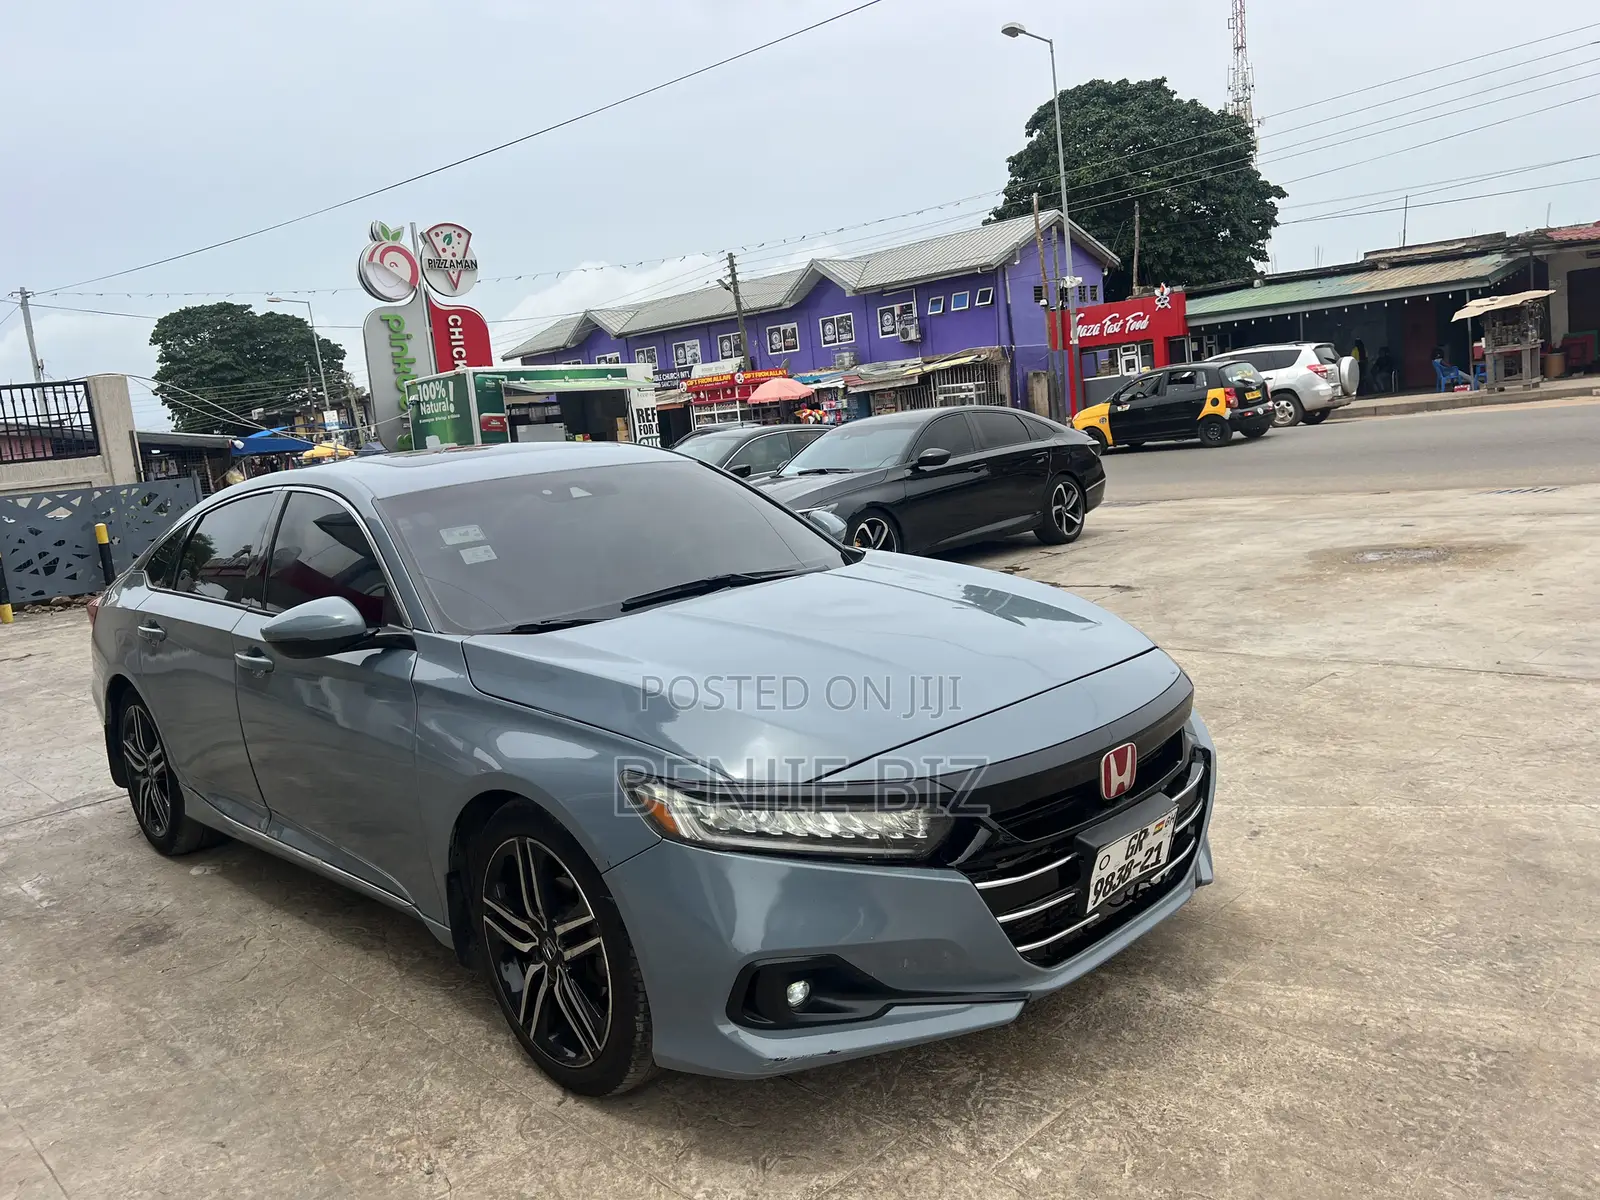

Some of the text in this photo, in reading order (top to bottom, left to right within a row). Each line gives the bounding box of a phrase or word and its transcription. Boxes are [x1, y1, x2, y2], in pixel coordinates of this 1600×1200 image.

[427, 258, 478, 270] PIZZAMAN
[1102, 312, 1124, 337] Fast
[1125, 311, 1150, 334] Food
[417, 380, 446, 402] 100%
[698, 377, 713, 385] FROM
[638, 424, 654, 436] FOR
[1124, 828, 1150, 861] GR
[1091, 841, 1164, 906] 9838-21
